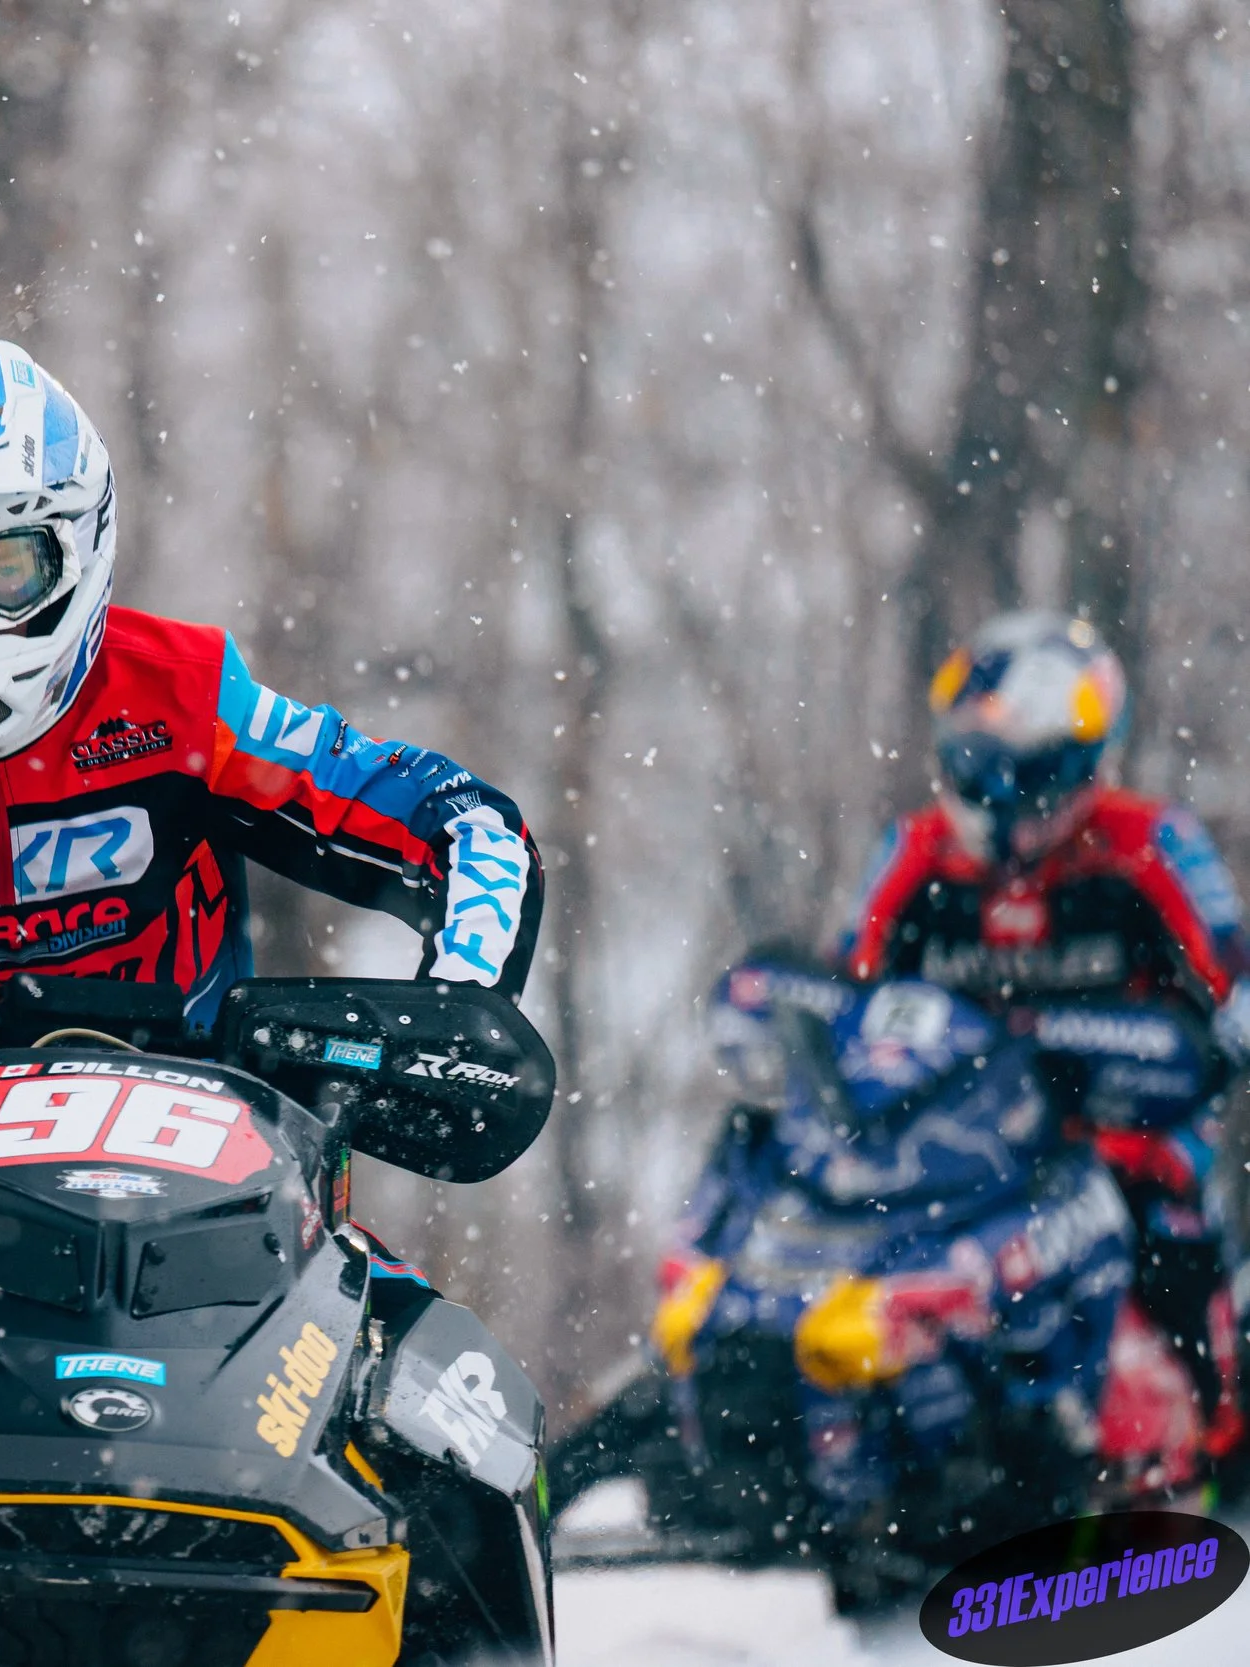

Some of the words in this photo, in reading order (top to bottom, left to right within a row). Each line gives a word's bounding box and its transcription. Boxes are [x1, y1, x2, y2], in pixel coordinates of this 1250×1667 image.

[71, 720, 167, 760] CLASSIC
[441, 821, 521, 977] FXR
[324, 1038, 381, 1064] THENE
[48, 1061, 224, 1093] DILLON
[446, 1061, 522, 1088] ROX
[59, 1354, 162, 1379] THENE
[256, 1321, 339, 1458] ski-doo
[418, 1350, 508, 1468] FXR
